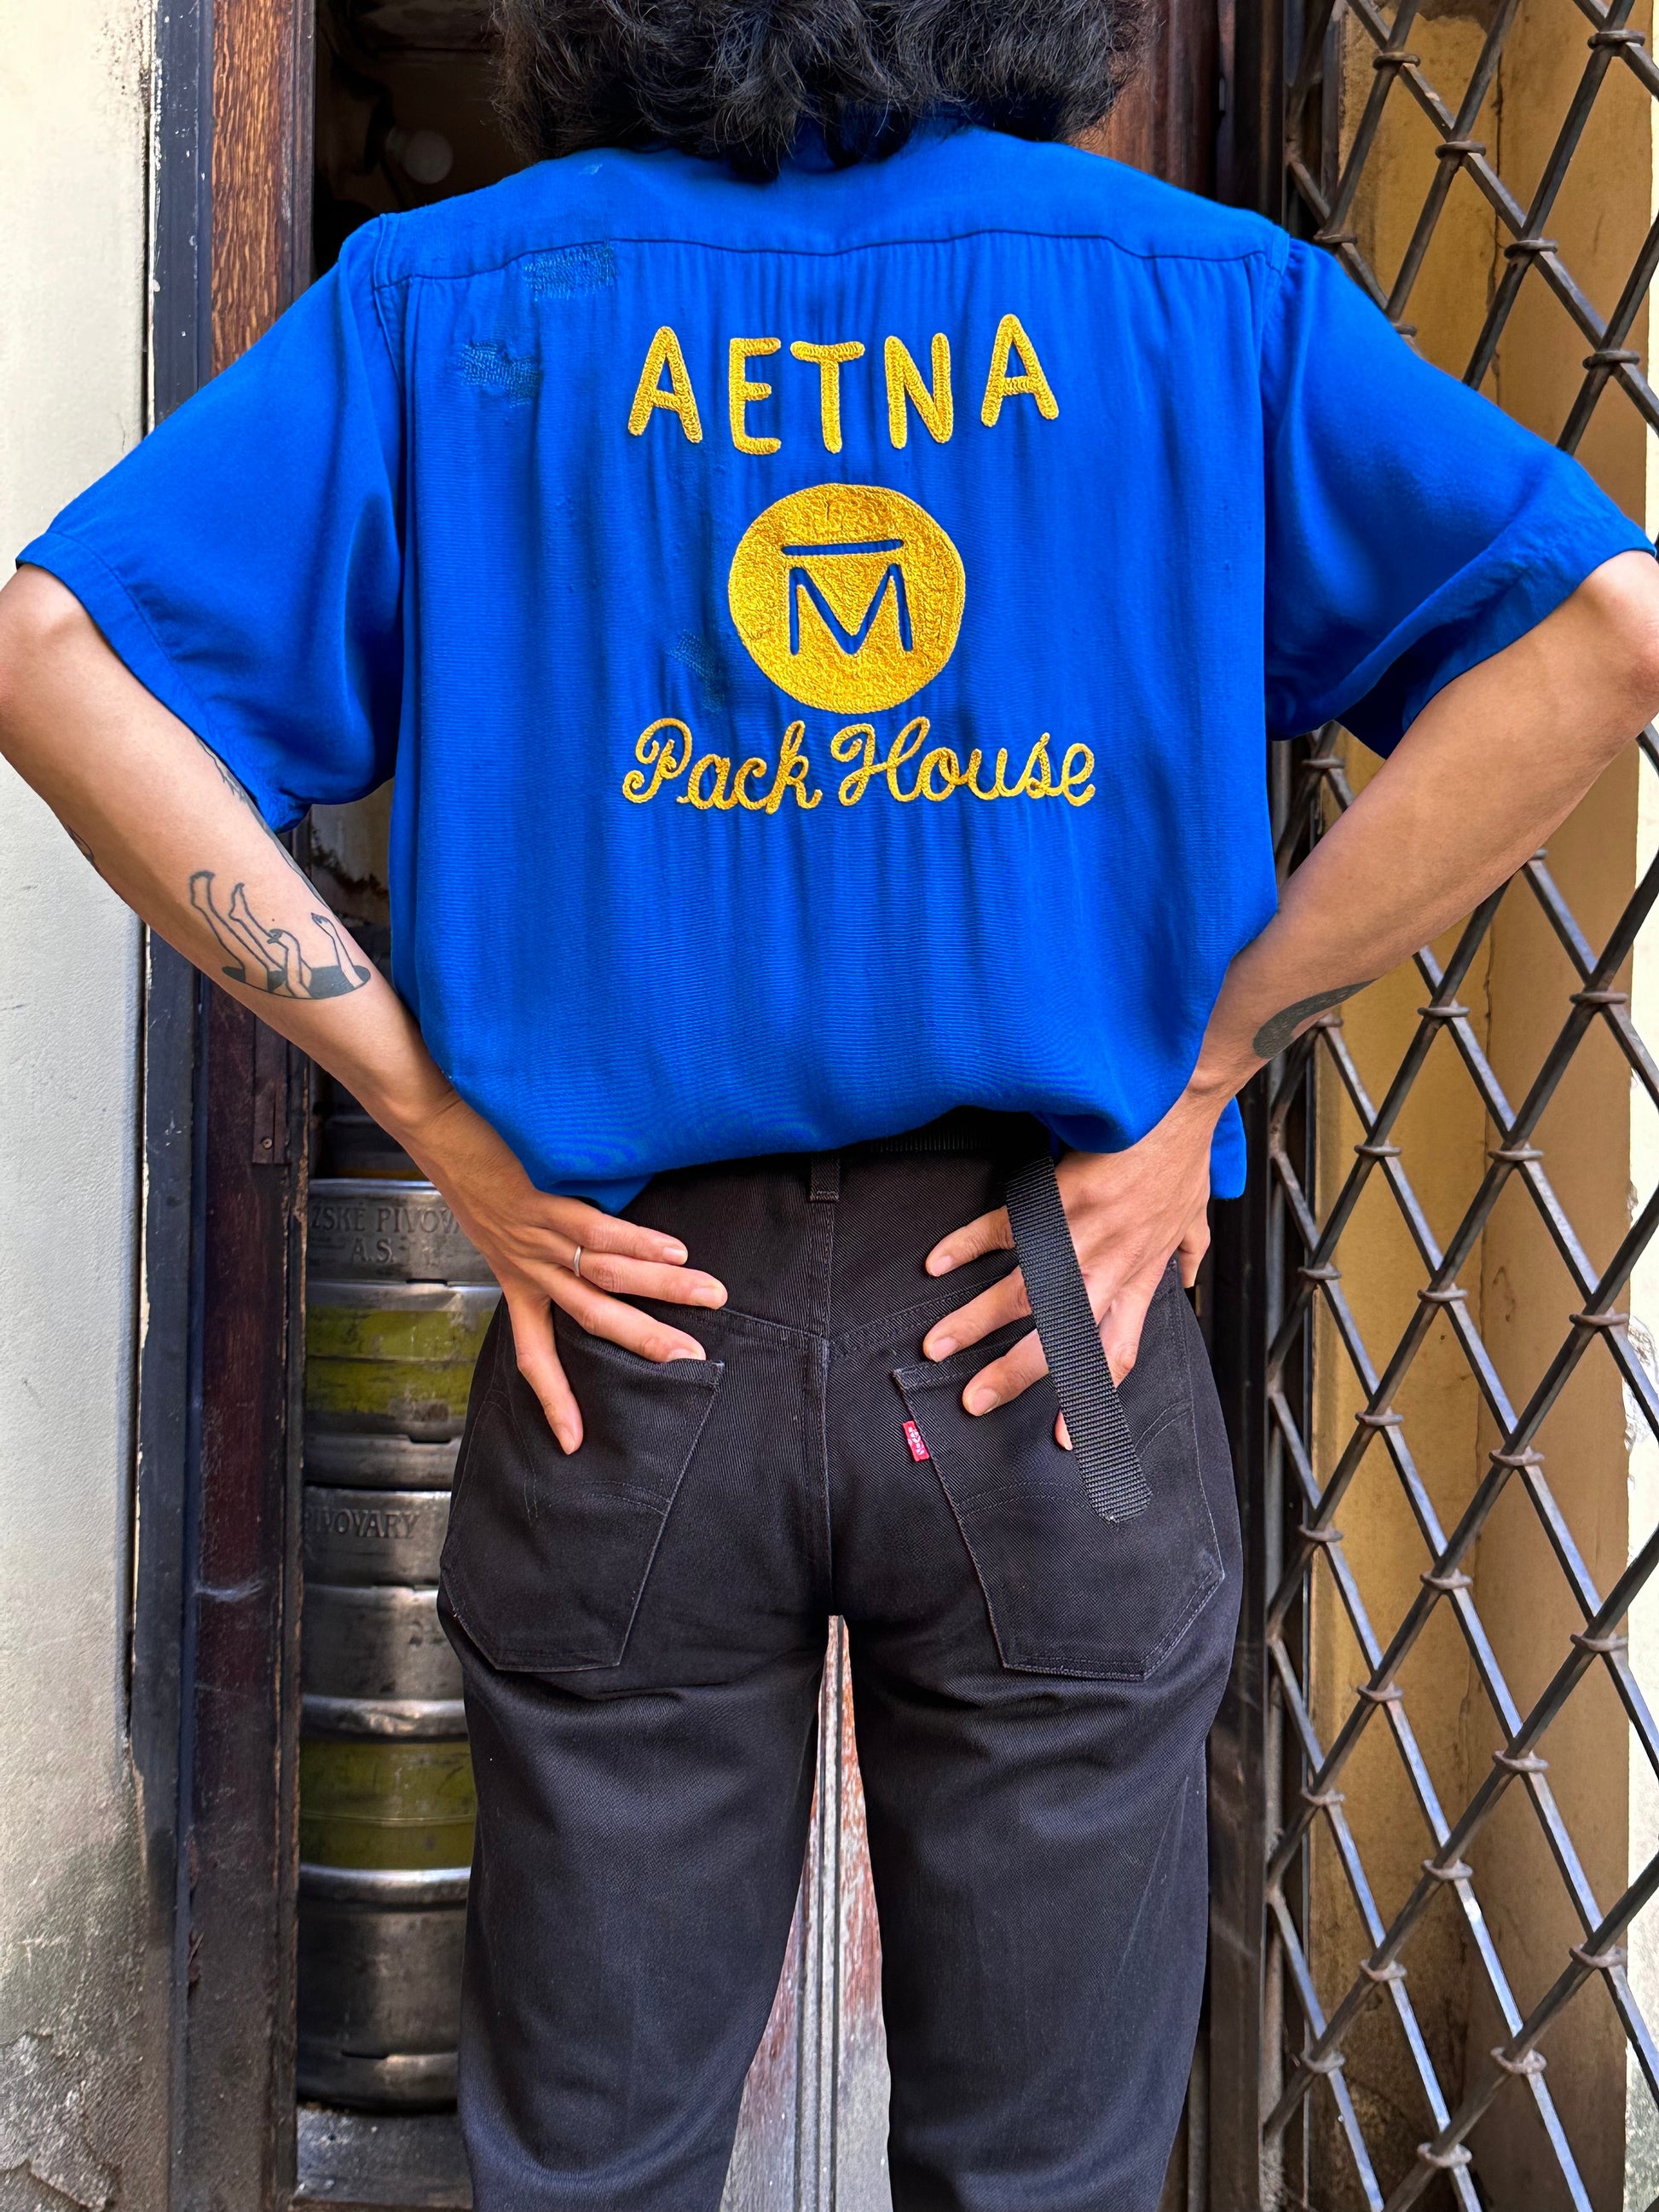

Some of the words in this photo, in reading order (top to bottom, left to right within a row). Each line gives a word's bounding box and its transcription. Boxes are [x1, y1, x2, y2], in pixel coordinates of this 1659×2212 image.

[628, 314, 1059, 454] AETNA
[622, 718, 822, 814] Pack
[830, 717, 1095, 806] House
